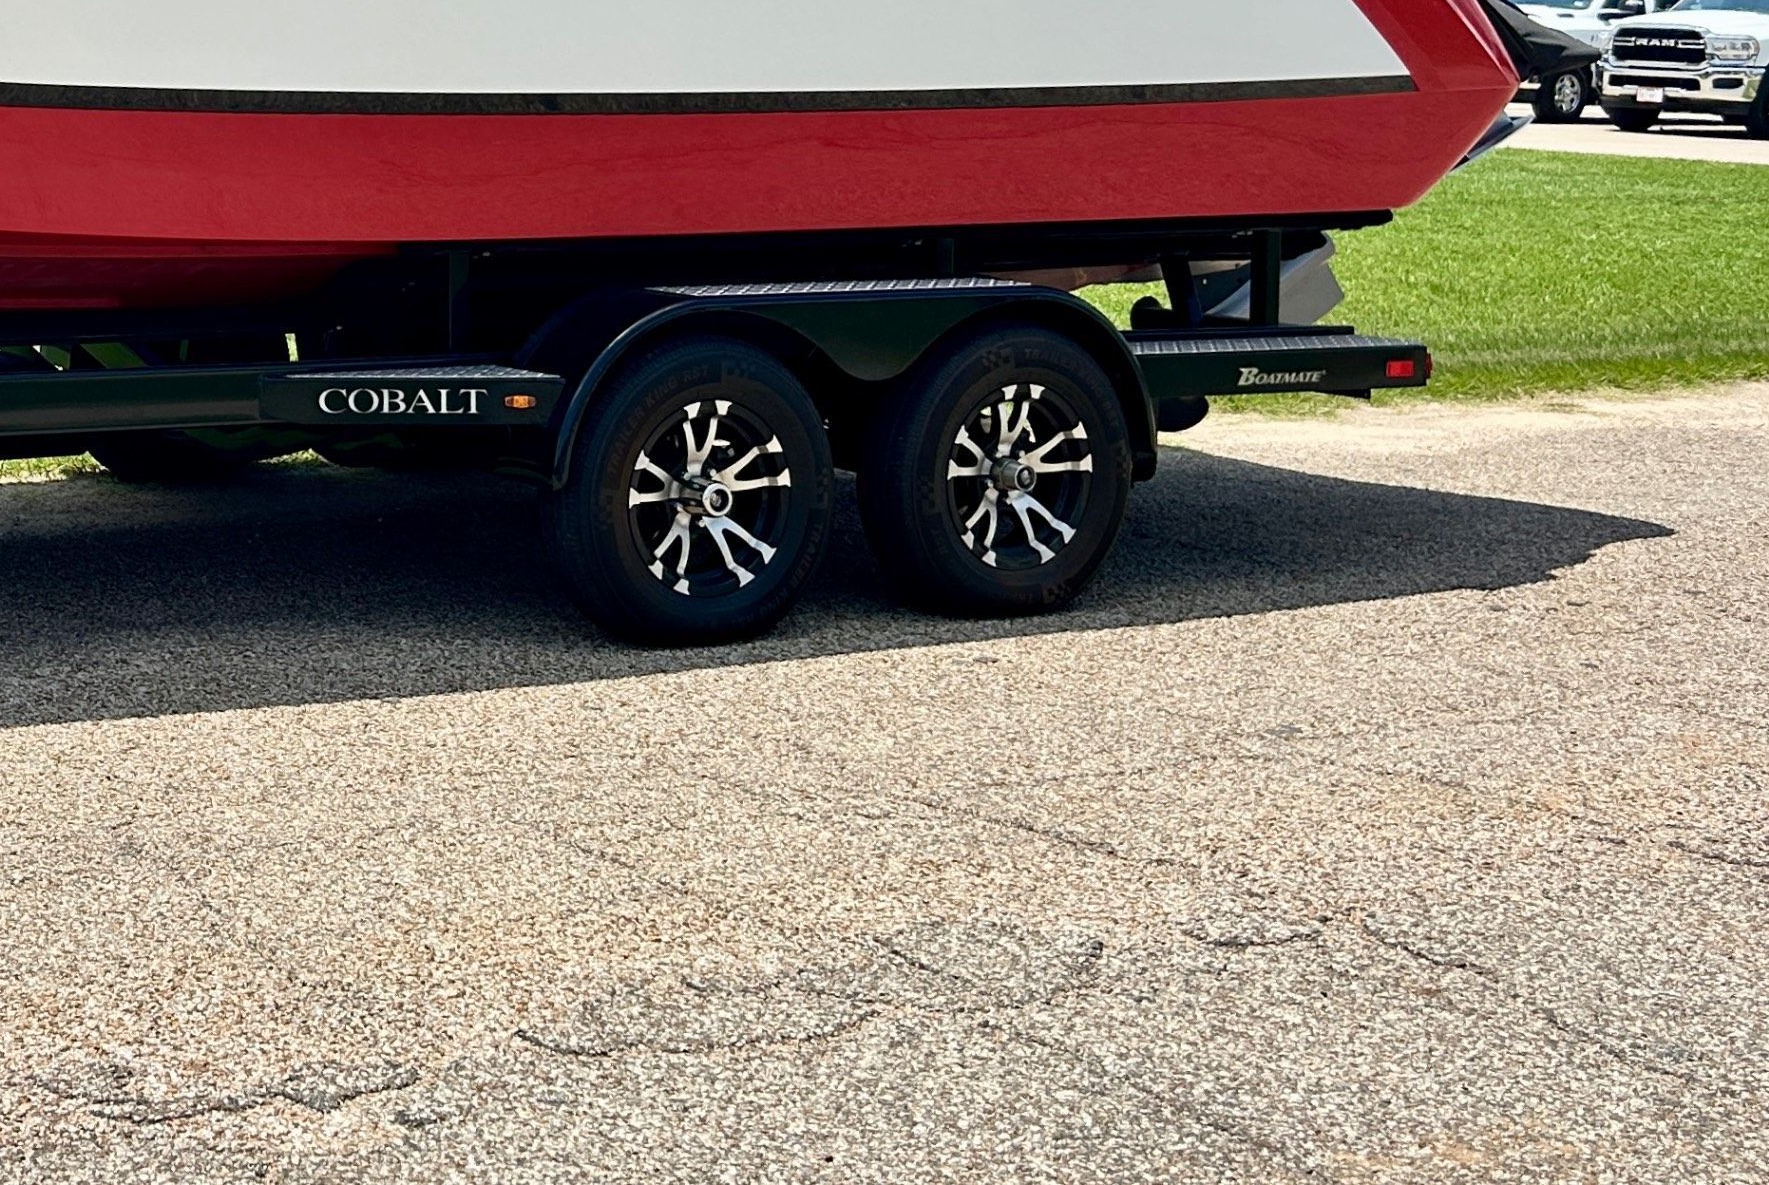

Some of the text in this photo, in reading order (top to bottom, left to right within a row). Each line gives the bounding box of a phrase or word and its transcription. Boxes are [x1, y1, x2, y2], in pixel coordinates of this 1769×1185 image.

[1635, 37, 1675, 47] RAM
[1237, 367, 1322, 386] BOATMATE
[318, 388, 489, 414] COBALT
